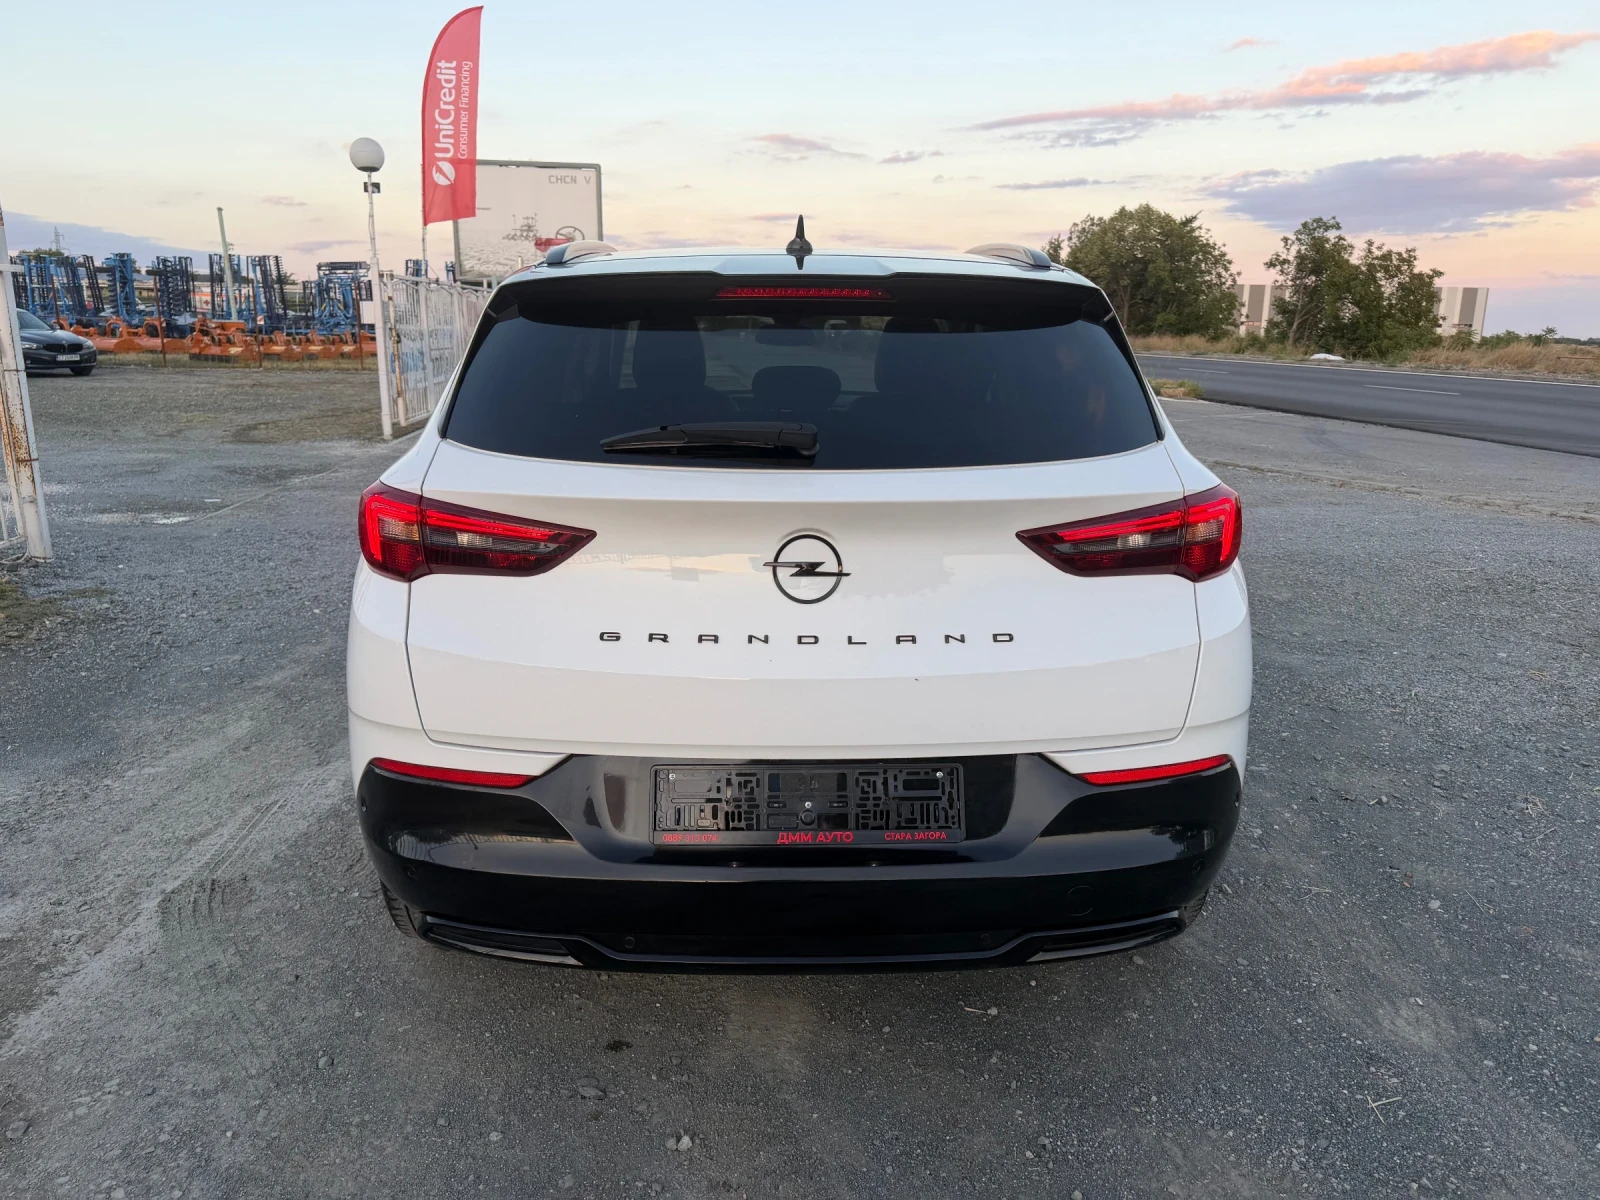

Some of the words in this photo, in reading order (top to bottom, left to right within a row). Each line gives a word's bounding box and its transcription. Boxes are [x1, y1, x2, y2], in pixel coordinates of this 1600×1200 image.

[458, 61, 473, 108] Financing
[433, 59, 457, 159] UniCredit
[457, 110, 469, 159] Consumer
[599, 631, 1015, 645] GRANDLAND
[662, 833, 683, 842] 0889
[685, 833, 700, 842] 313
[702, 833, 718, 842] 074
[776, 831, 812, 845] ДММ
[816, 831, 854, 843] АУТО
[884, 832, 912, 841] СТАРА
[914, 831, 947, 840] ЗАГОРА
